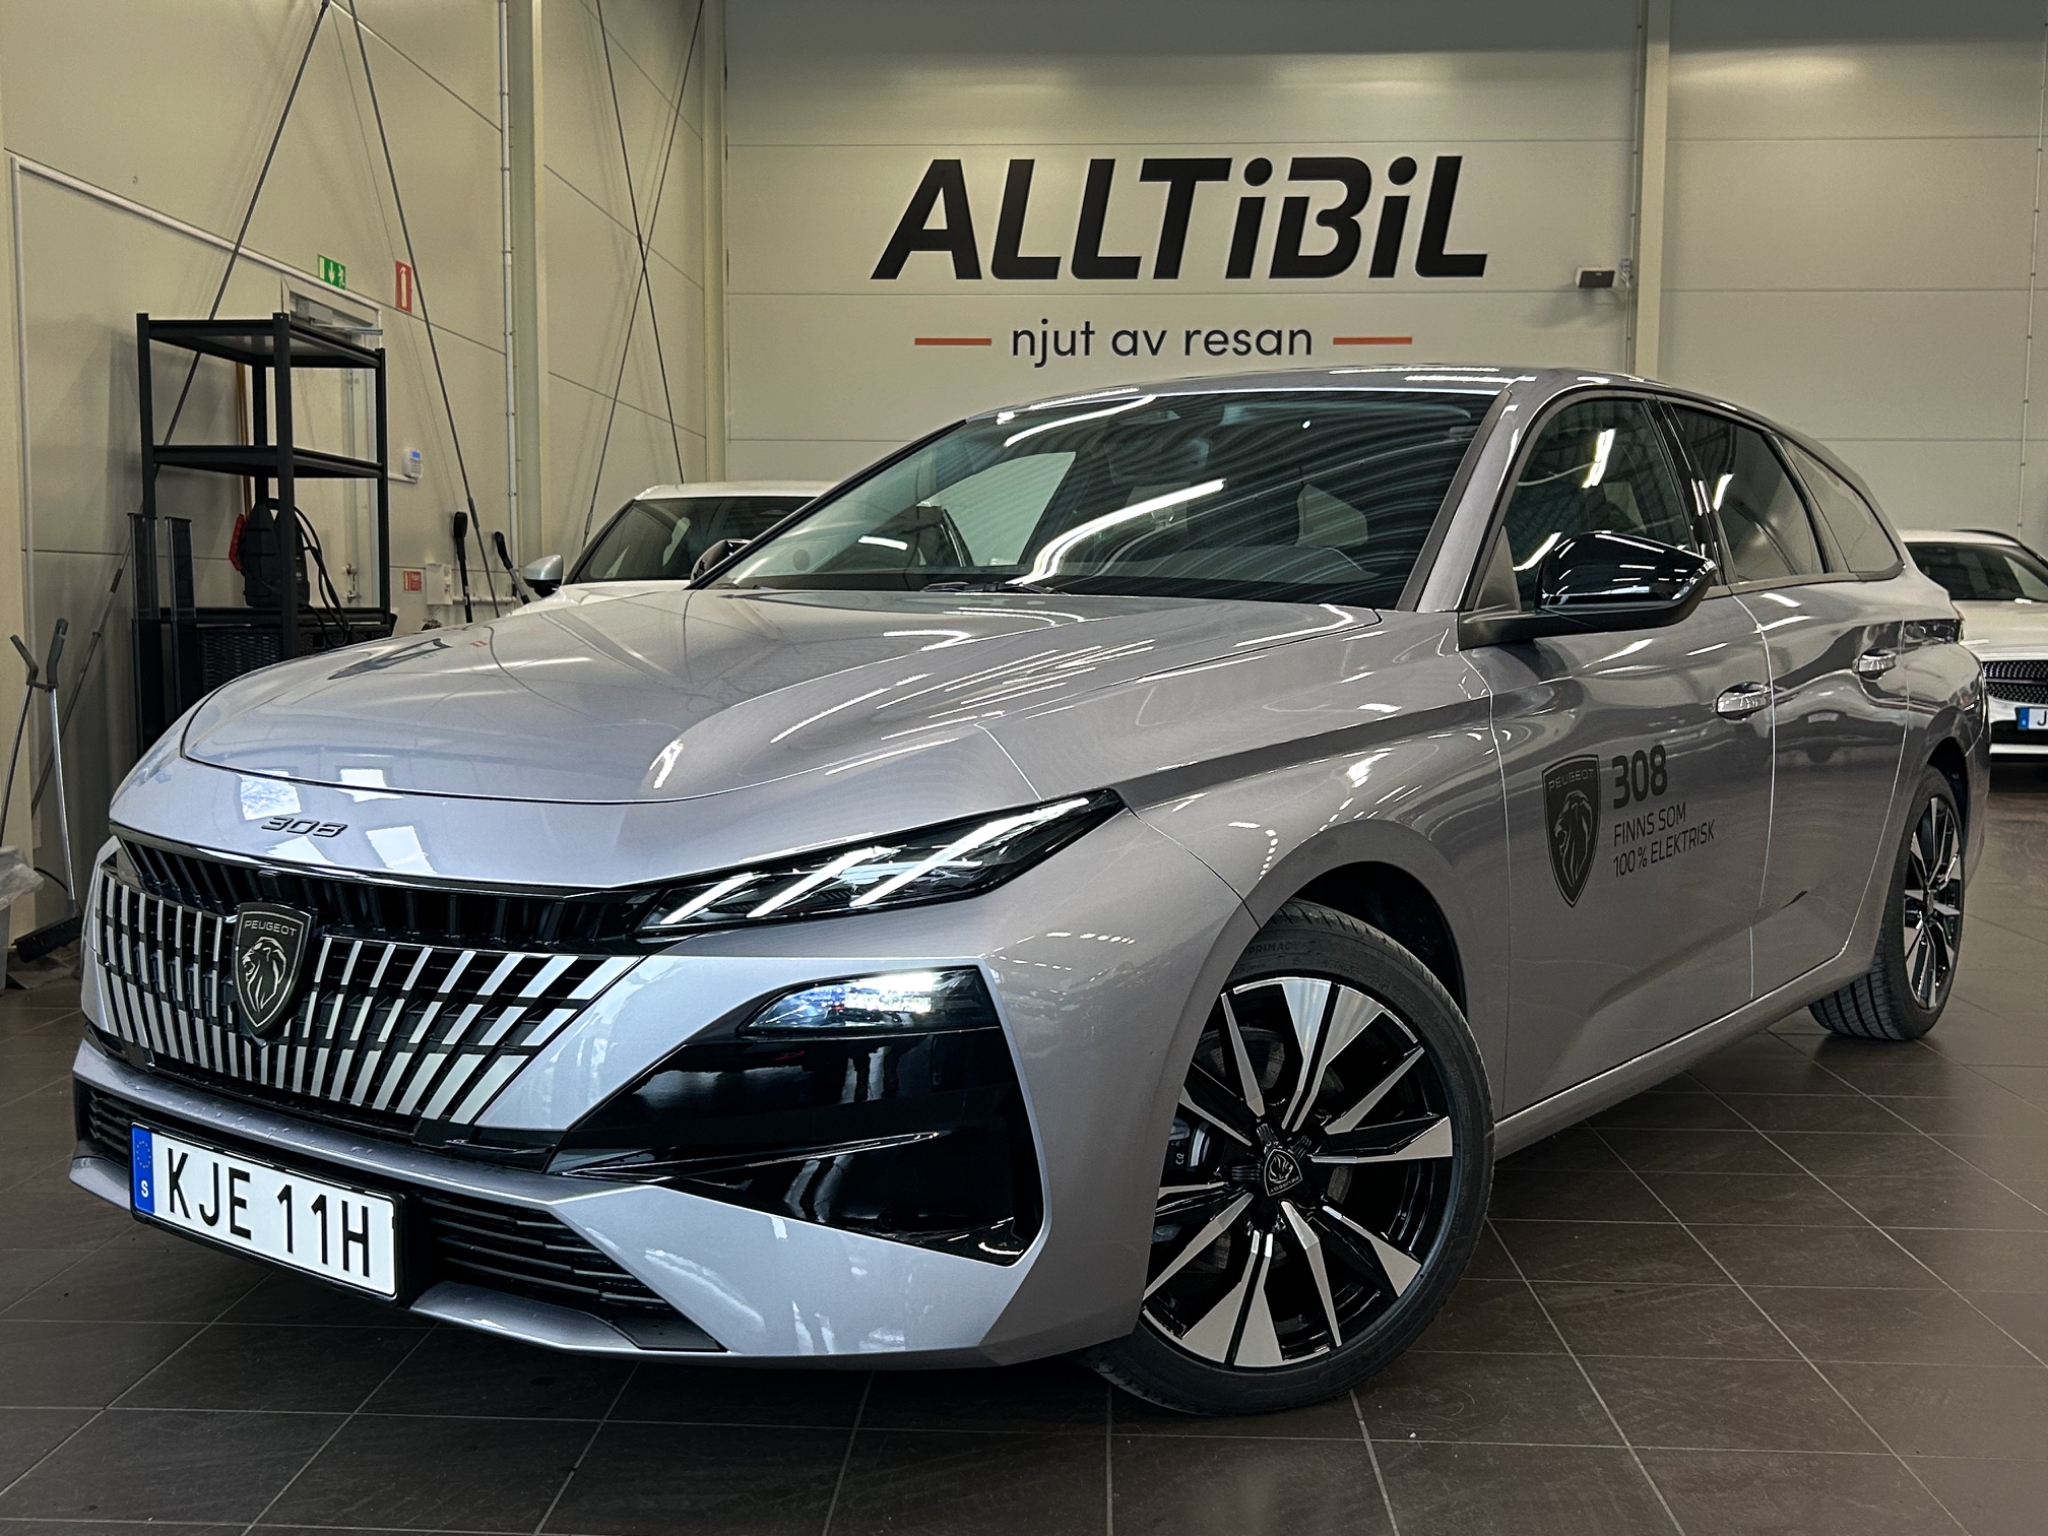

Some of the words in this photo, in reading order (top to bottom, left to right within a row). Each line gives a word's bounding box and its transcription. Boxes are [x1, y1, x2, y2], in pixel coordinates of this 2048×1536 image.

[1011, 317, 1096, 368] njut
[1111, 328, 1169, 357] av
[1184, 327, 1313, 357] resan
[1548, 767, 1595, 791] PEUGEOT
[1611, 744, 1668, 810] 308
[261, 816, 348, 838] 308
[1613, 812, 1655, 848] FINNS
[1658, 801, 1687, 832] SOM
[1650, 819, 1716, 864] ELEKTRISK
[244, 919, 297, 937] PEUGEOT
[140, 1179, 149, 1198] S
[167, 1147, 252, 1241] KJE
[276, 1183, 371, 1278] 11H
